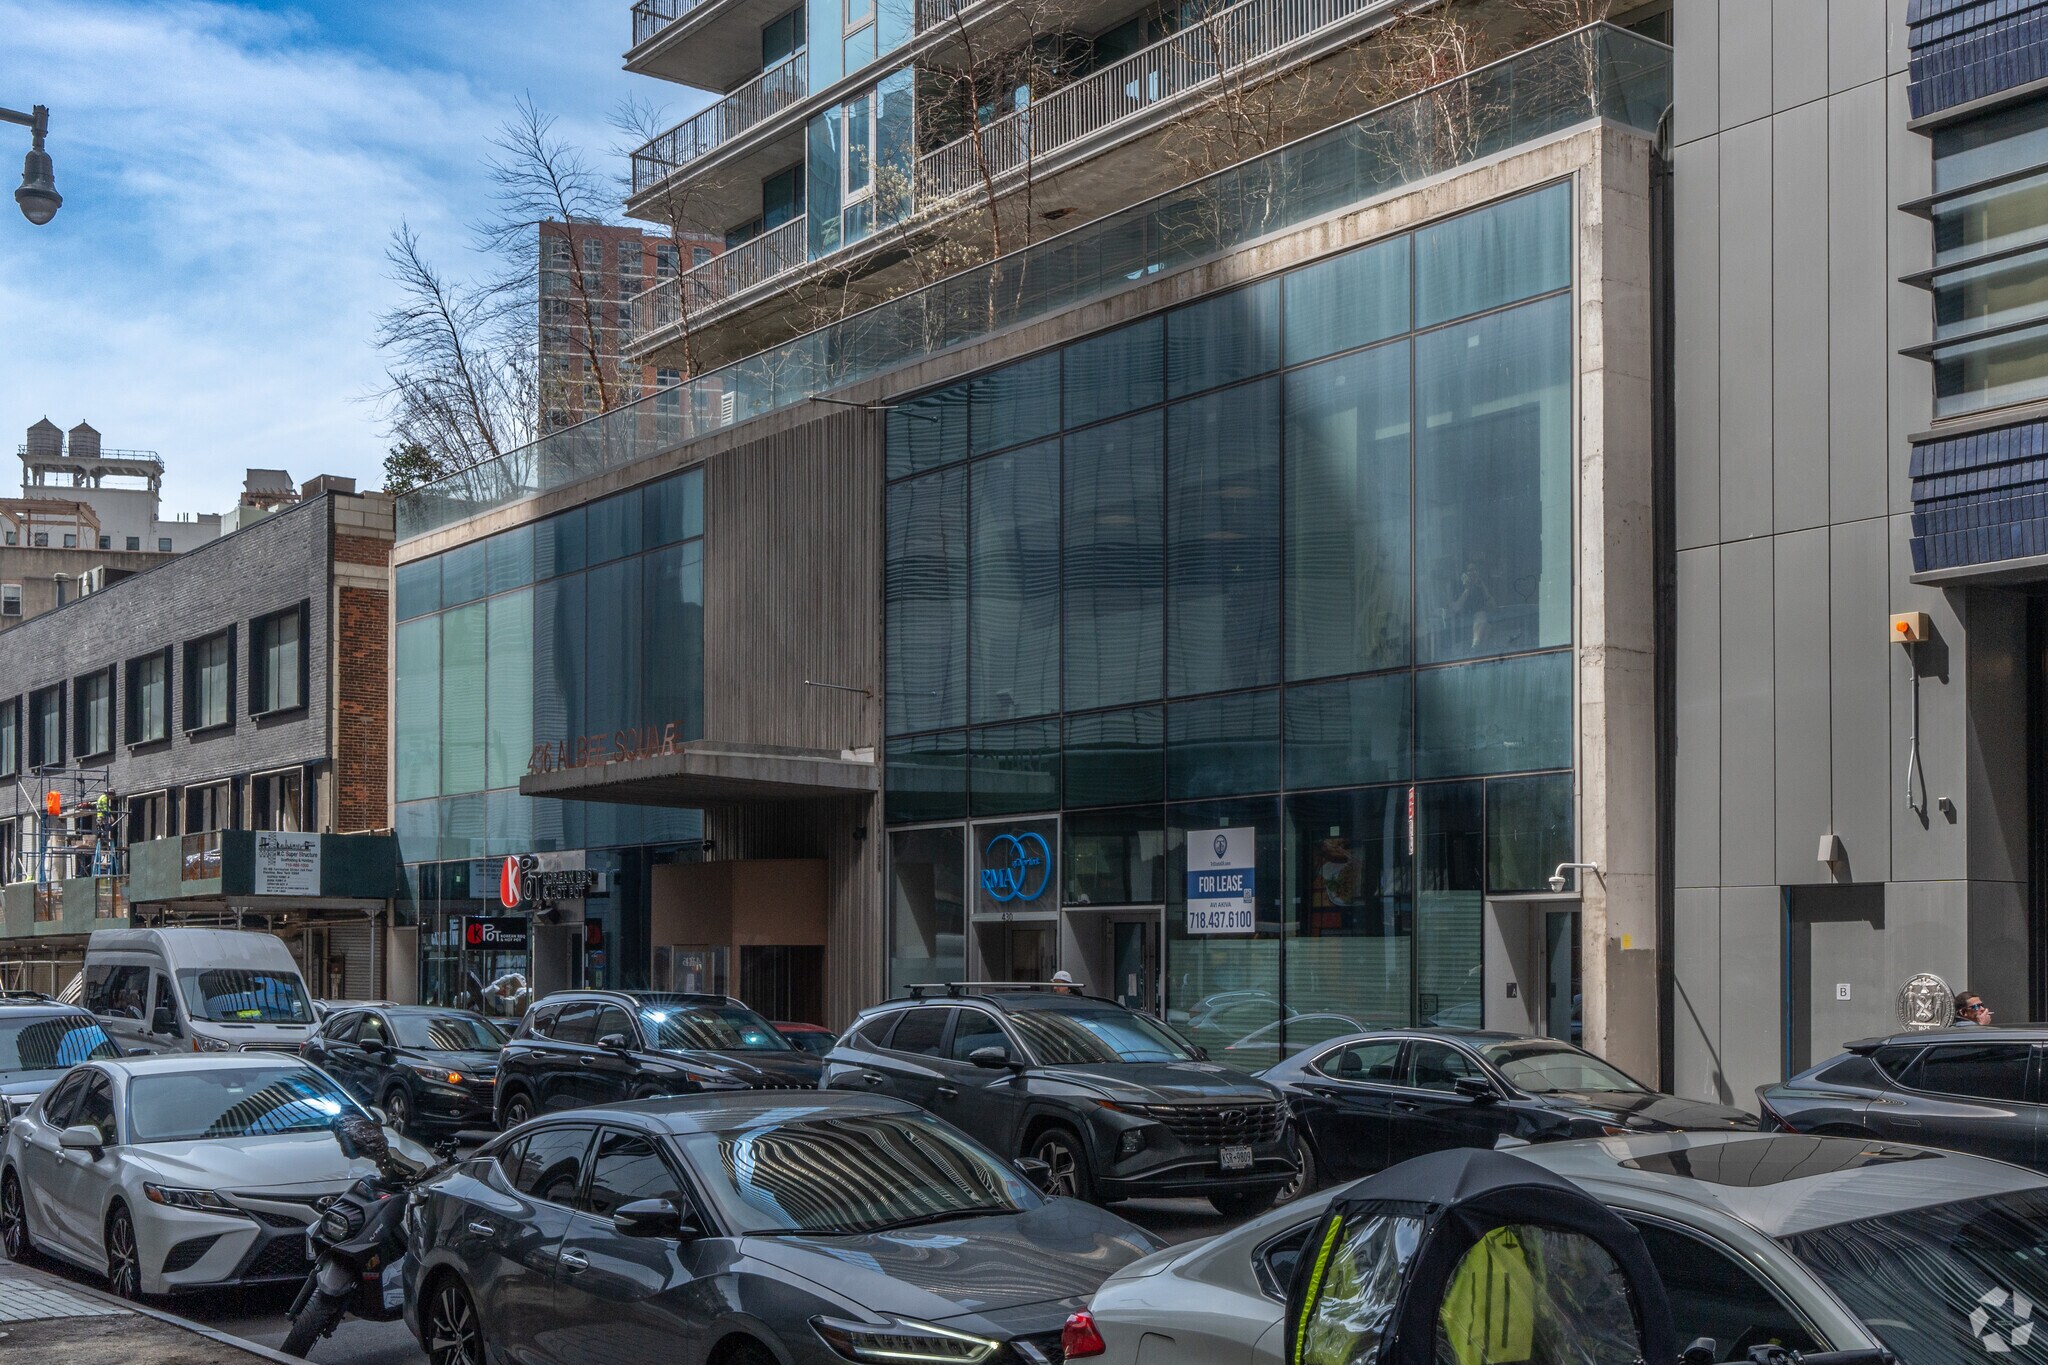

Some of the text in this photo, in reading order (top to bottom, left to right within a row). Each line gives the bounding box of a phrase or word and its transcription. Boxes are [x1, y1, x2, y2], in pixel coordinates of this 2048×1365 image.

[527, 719, 686, 774] 436 ALBEE SQUARE
[542, 871, 574, 885] KOREAN
[981, 867, 1017, 889] RMA
[1198, 875, 1243, 893] FOR LEASE
[542, 884, 585, 900] & HOT POT
[1001, 912, 1014, 921] 430
[1189, 910, 1252, 929] 718.437.6100
[1840, 987, 1847, 996] B
